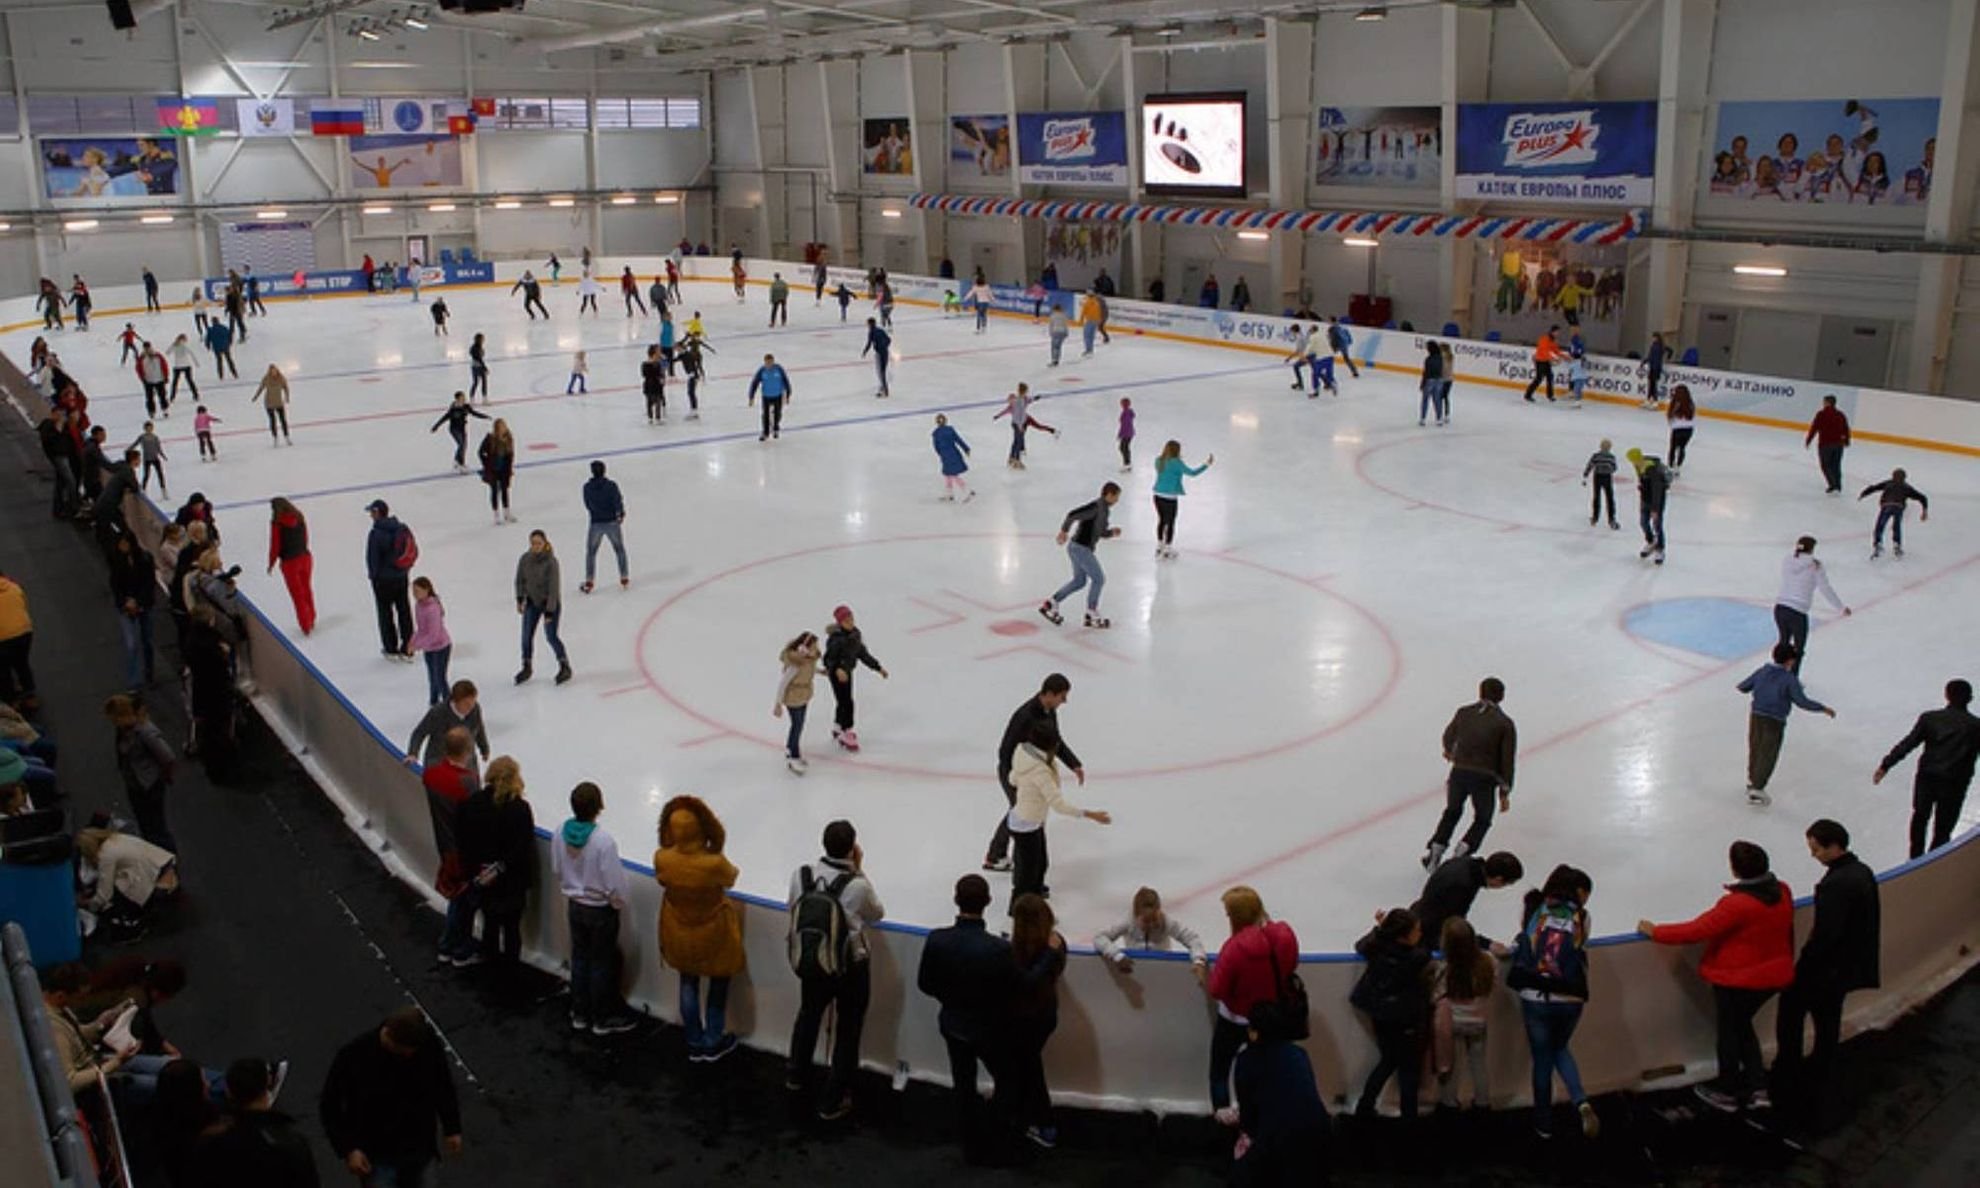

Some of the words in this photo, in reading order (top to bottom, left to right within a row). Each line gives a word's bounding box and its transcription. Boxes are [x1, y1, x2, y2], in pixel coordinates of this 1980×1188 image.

[1477, 181, 1518, 196] КАТОК
[1520, 182, 1577, 198] ЕВРОПЫ
[1580, 183, 1627, 199] ПЛЮС
[1454, 343, 1528, 362] спортивной
[1724, 377, 1796, 398] катанию
